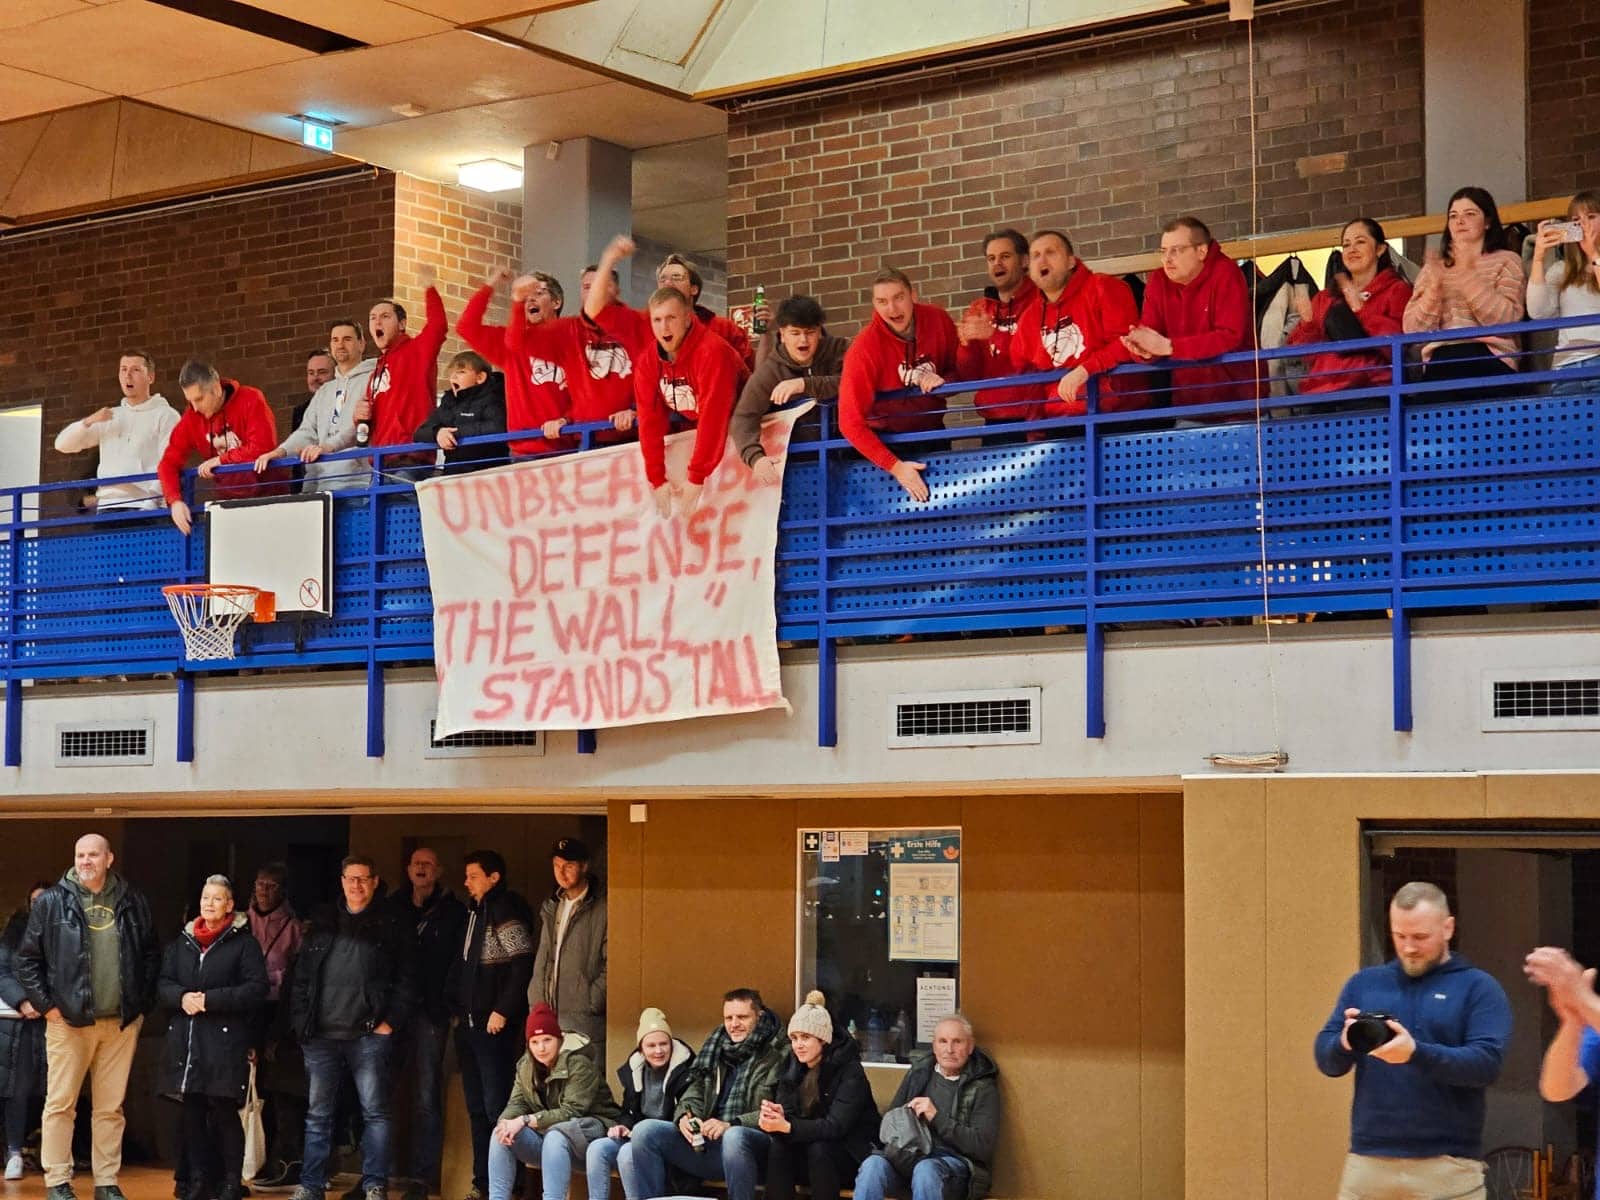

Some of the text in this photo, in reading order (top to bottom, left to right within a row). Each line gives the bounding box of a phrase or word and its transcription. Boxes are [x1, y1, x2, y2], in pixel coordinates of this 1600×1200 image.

[508, 500, 761, 598] DEFENSE,
[472, 634, 779, 723] STANDS TALL
[906, 839, 942, 849] Erste Hilfe
